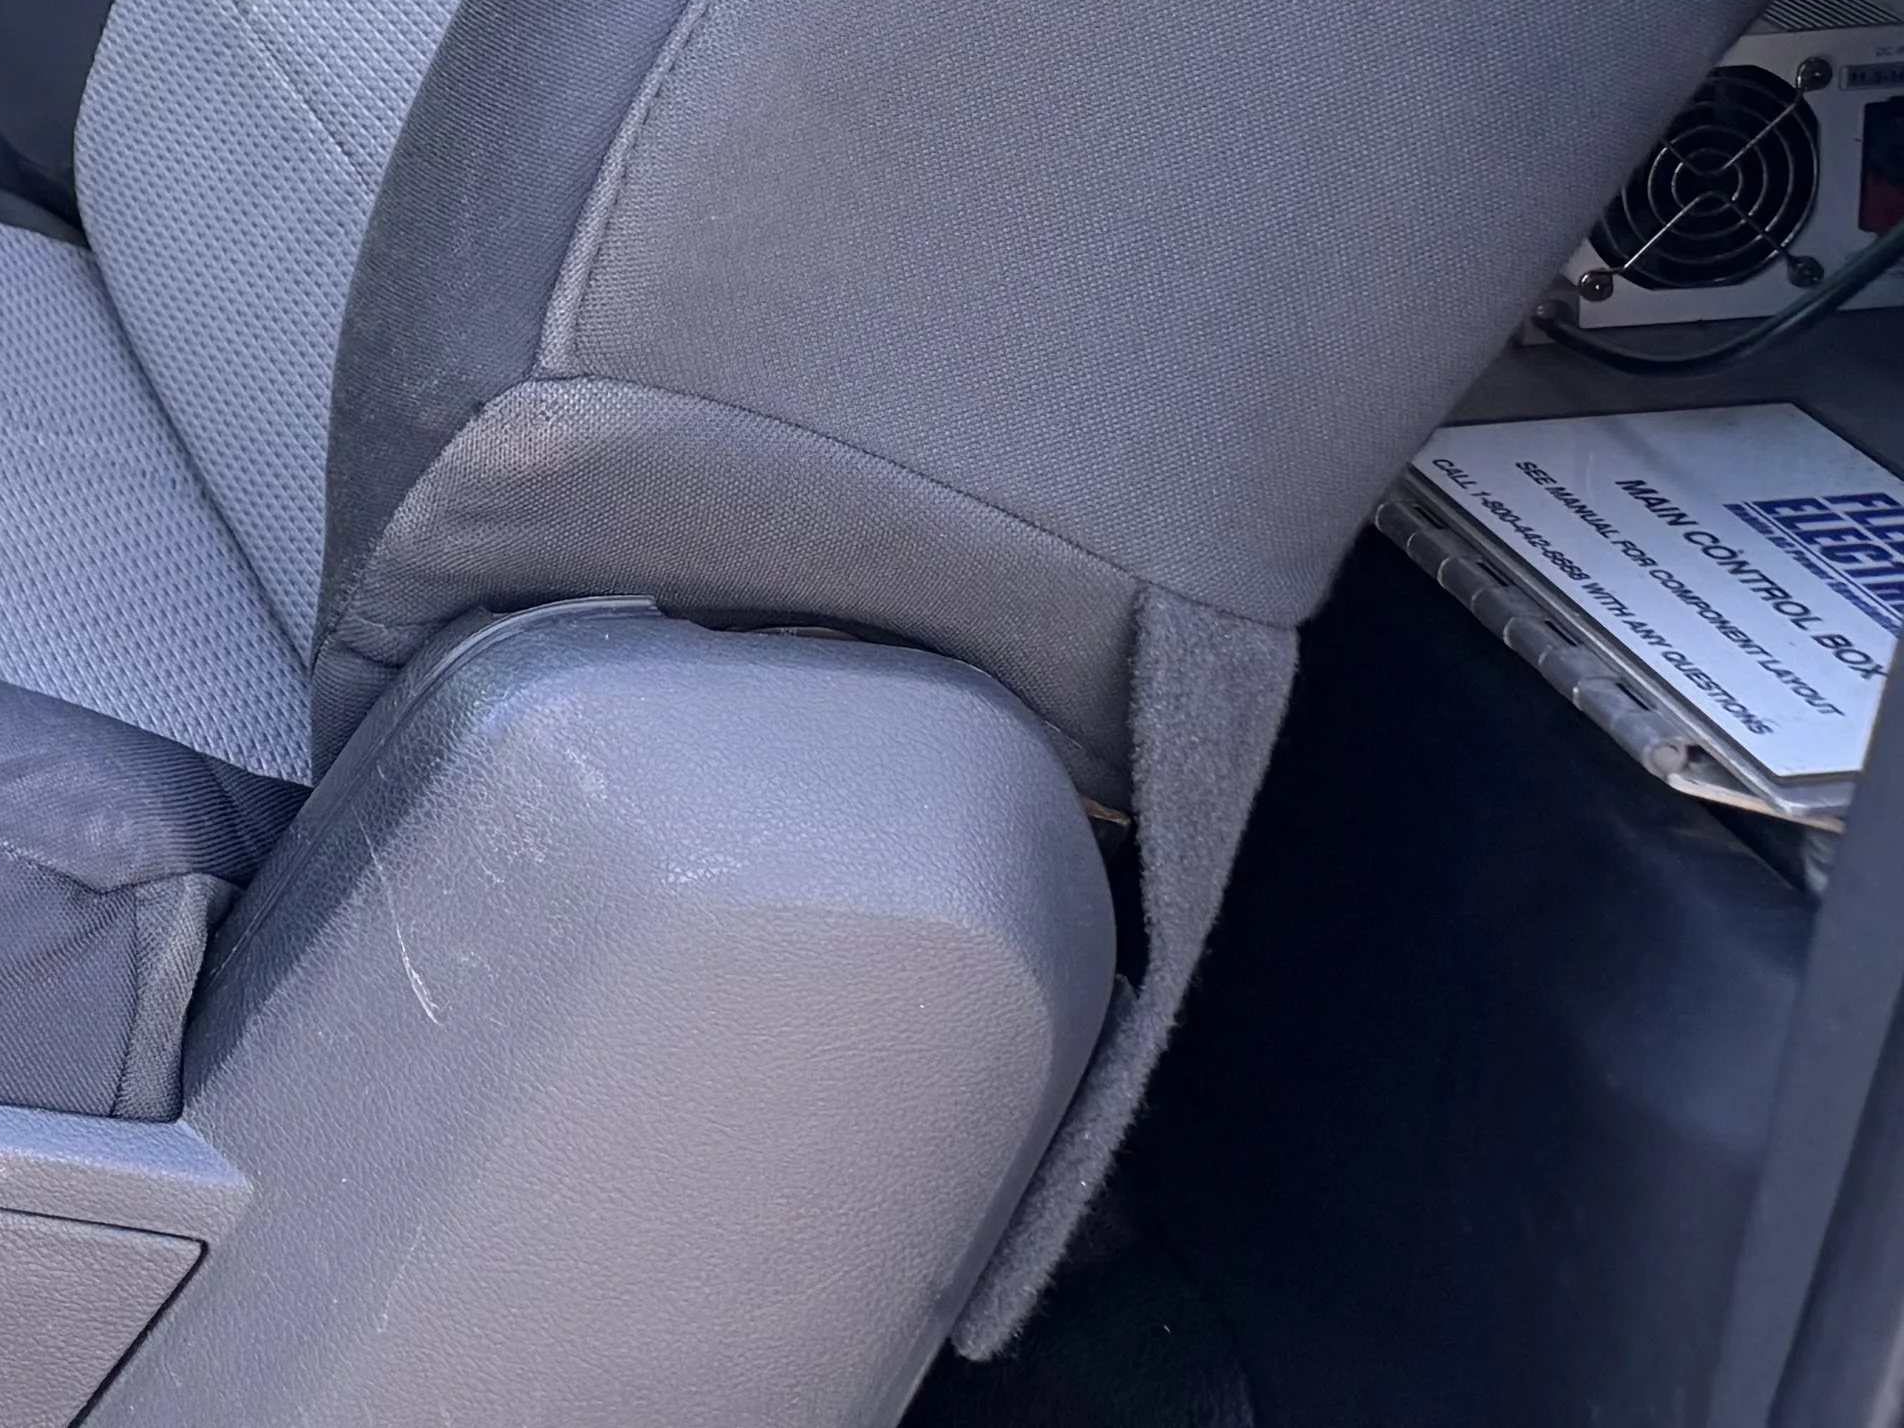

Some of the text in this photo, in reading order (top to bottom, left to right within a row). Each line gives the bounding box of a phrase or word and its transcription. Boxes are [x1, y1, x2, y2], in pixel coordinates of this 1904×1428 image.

[1432, 458, 1477, 490] CALL
[1581, 582, 1636, 618] WITH
[1623, 618, 1672, 648] ANY
[1661, 649, 1775, 736] QUESTIONS
[1515, 461, 1846, 717] SEE MANUAL FOR COMPONENT LAYOUT
[1615, 479, 1889, 680] MAIN CONTROL BOX
